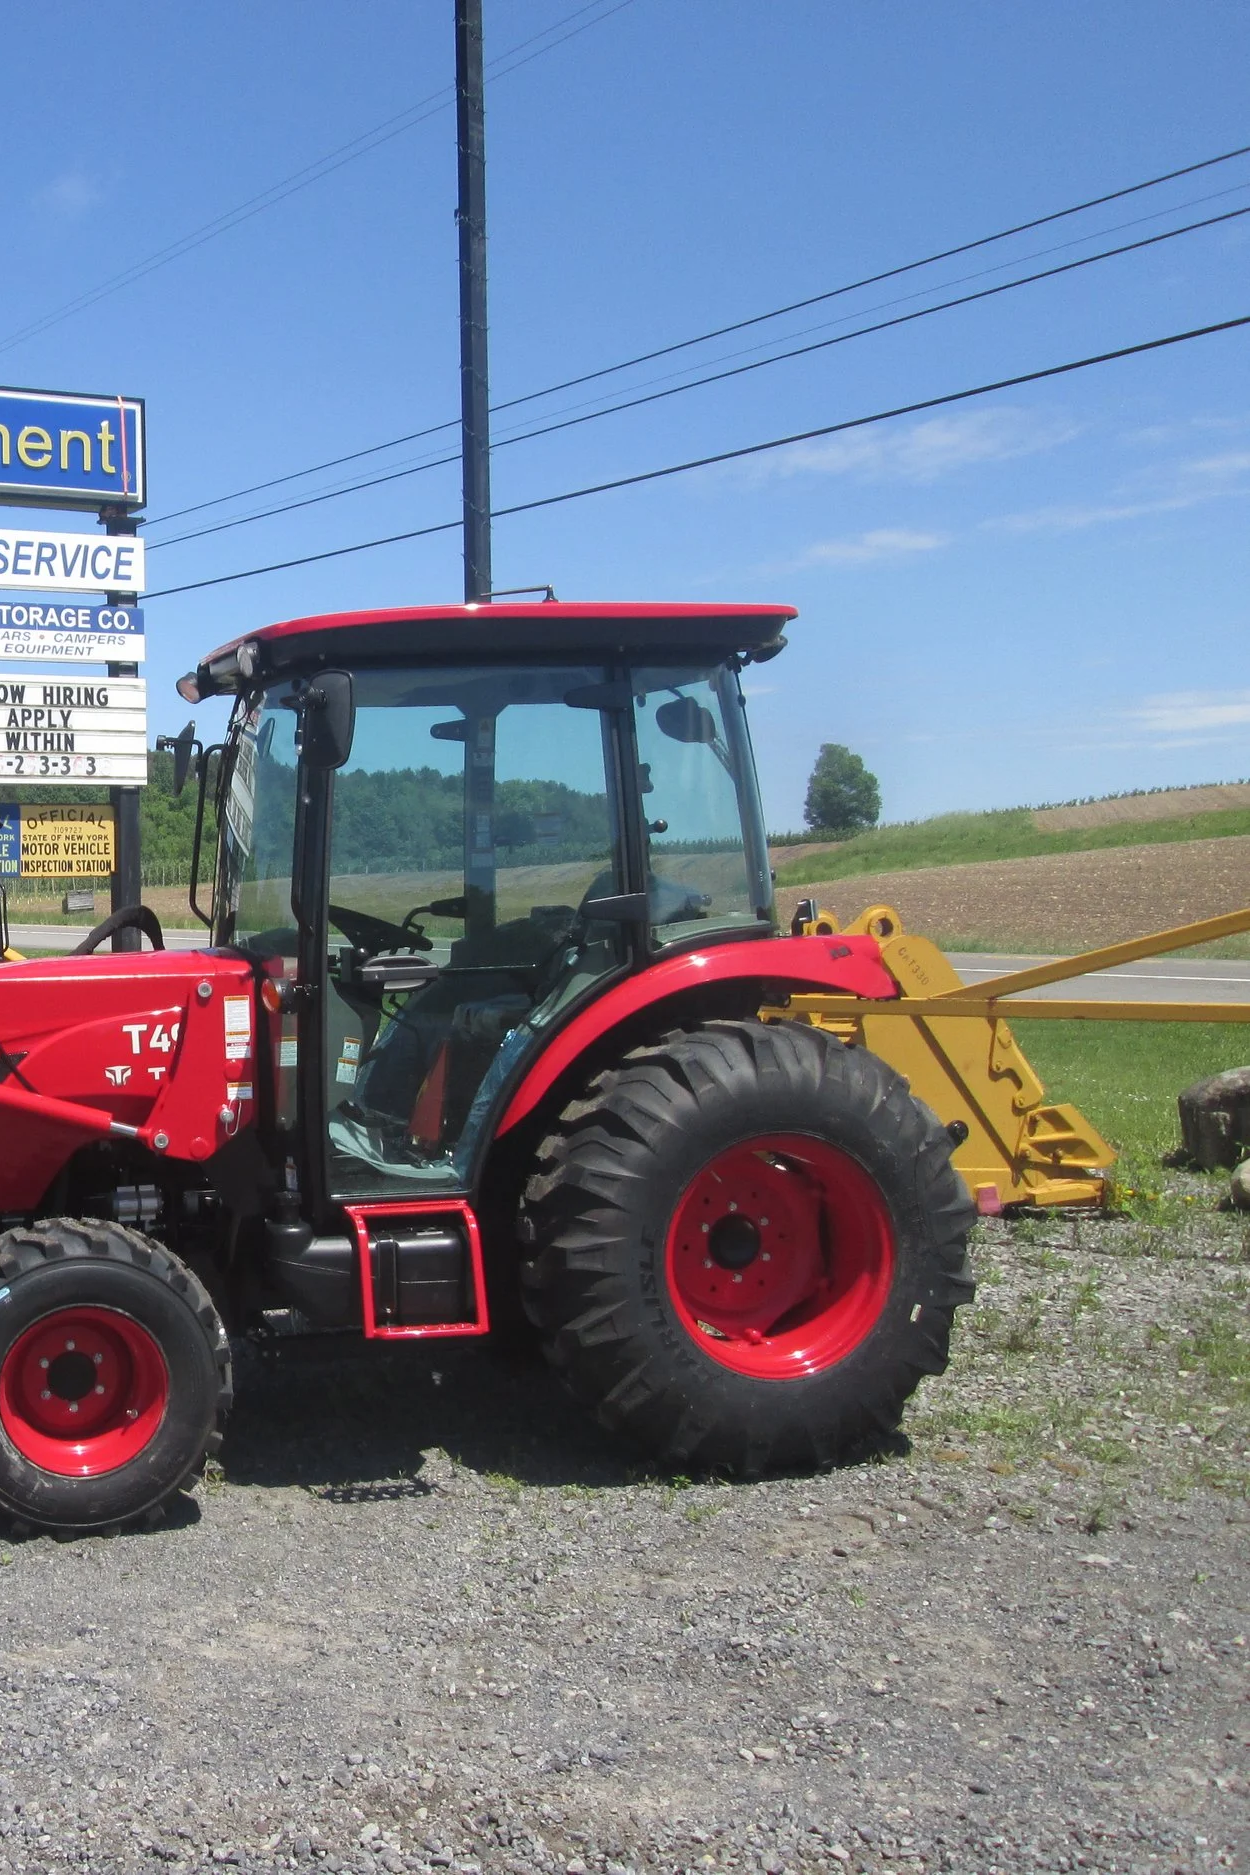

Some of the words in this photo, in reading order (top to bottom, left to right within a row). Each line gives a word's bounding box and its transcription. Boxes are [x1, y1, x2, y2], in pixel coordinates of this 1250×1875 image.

[98, 611, 136, 630] CO.
[54, 633, 126, 645] CAMPERS
[4, 643, 94, 656] EQUIPMENT
[43, 685, 109, 707] HIRING
[7, 709, 72, 728] APPLY
[5, 732, 75, 752] WITHIN
[27, 809, 106, 830] OFFICIAL
[21, 843, 59, 855] MOTOR
[63, 843, 110, 855] VEHICLE
[21, 859, 73, 873] INSPECTION
[76, 859, 111, 872] STATION
